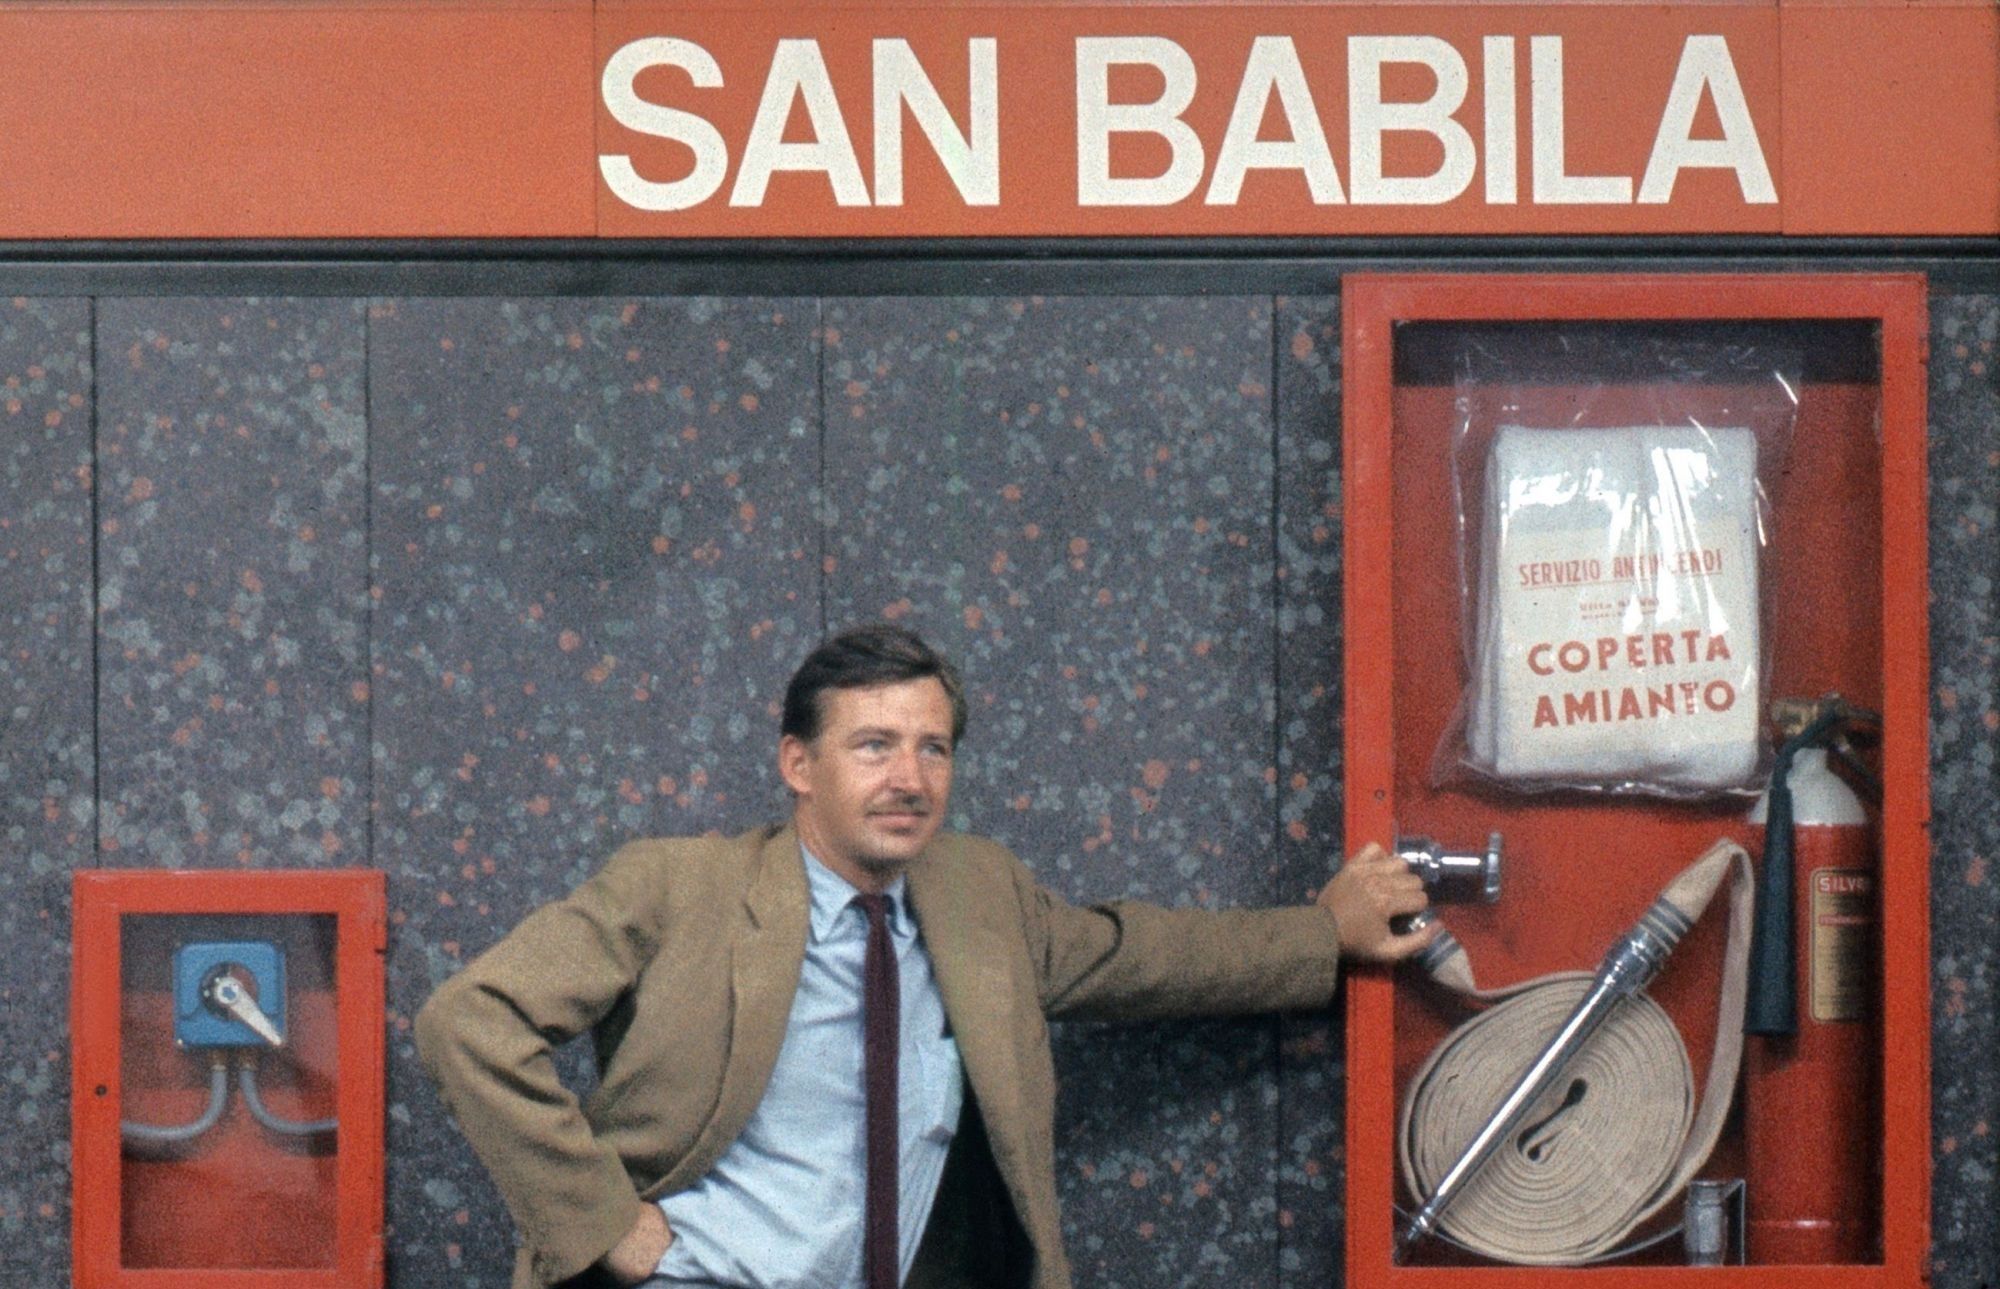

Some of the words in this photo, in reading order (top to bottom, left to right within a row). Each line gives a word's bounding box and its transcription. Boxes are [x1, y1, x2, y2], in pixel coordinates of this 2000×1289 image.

[598, 35, 1000, 211] SAN
[1075, 34, 1778, 206] BABILA
[1519, 558, 1600, 587] SERVIZIO
[1612, 548, 1723, 579] ANTINENDI
[1527, 630, 1732, 676] COPERTA
[1533, 680, 1736, 729] AMIANTO
